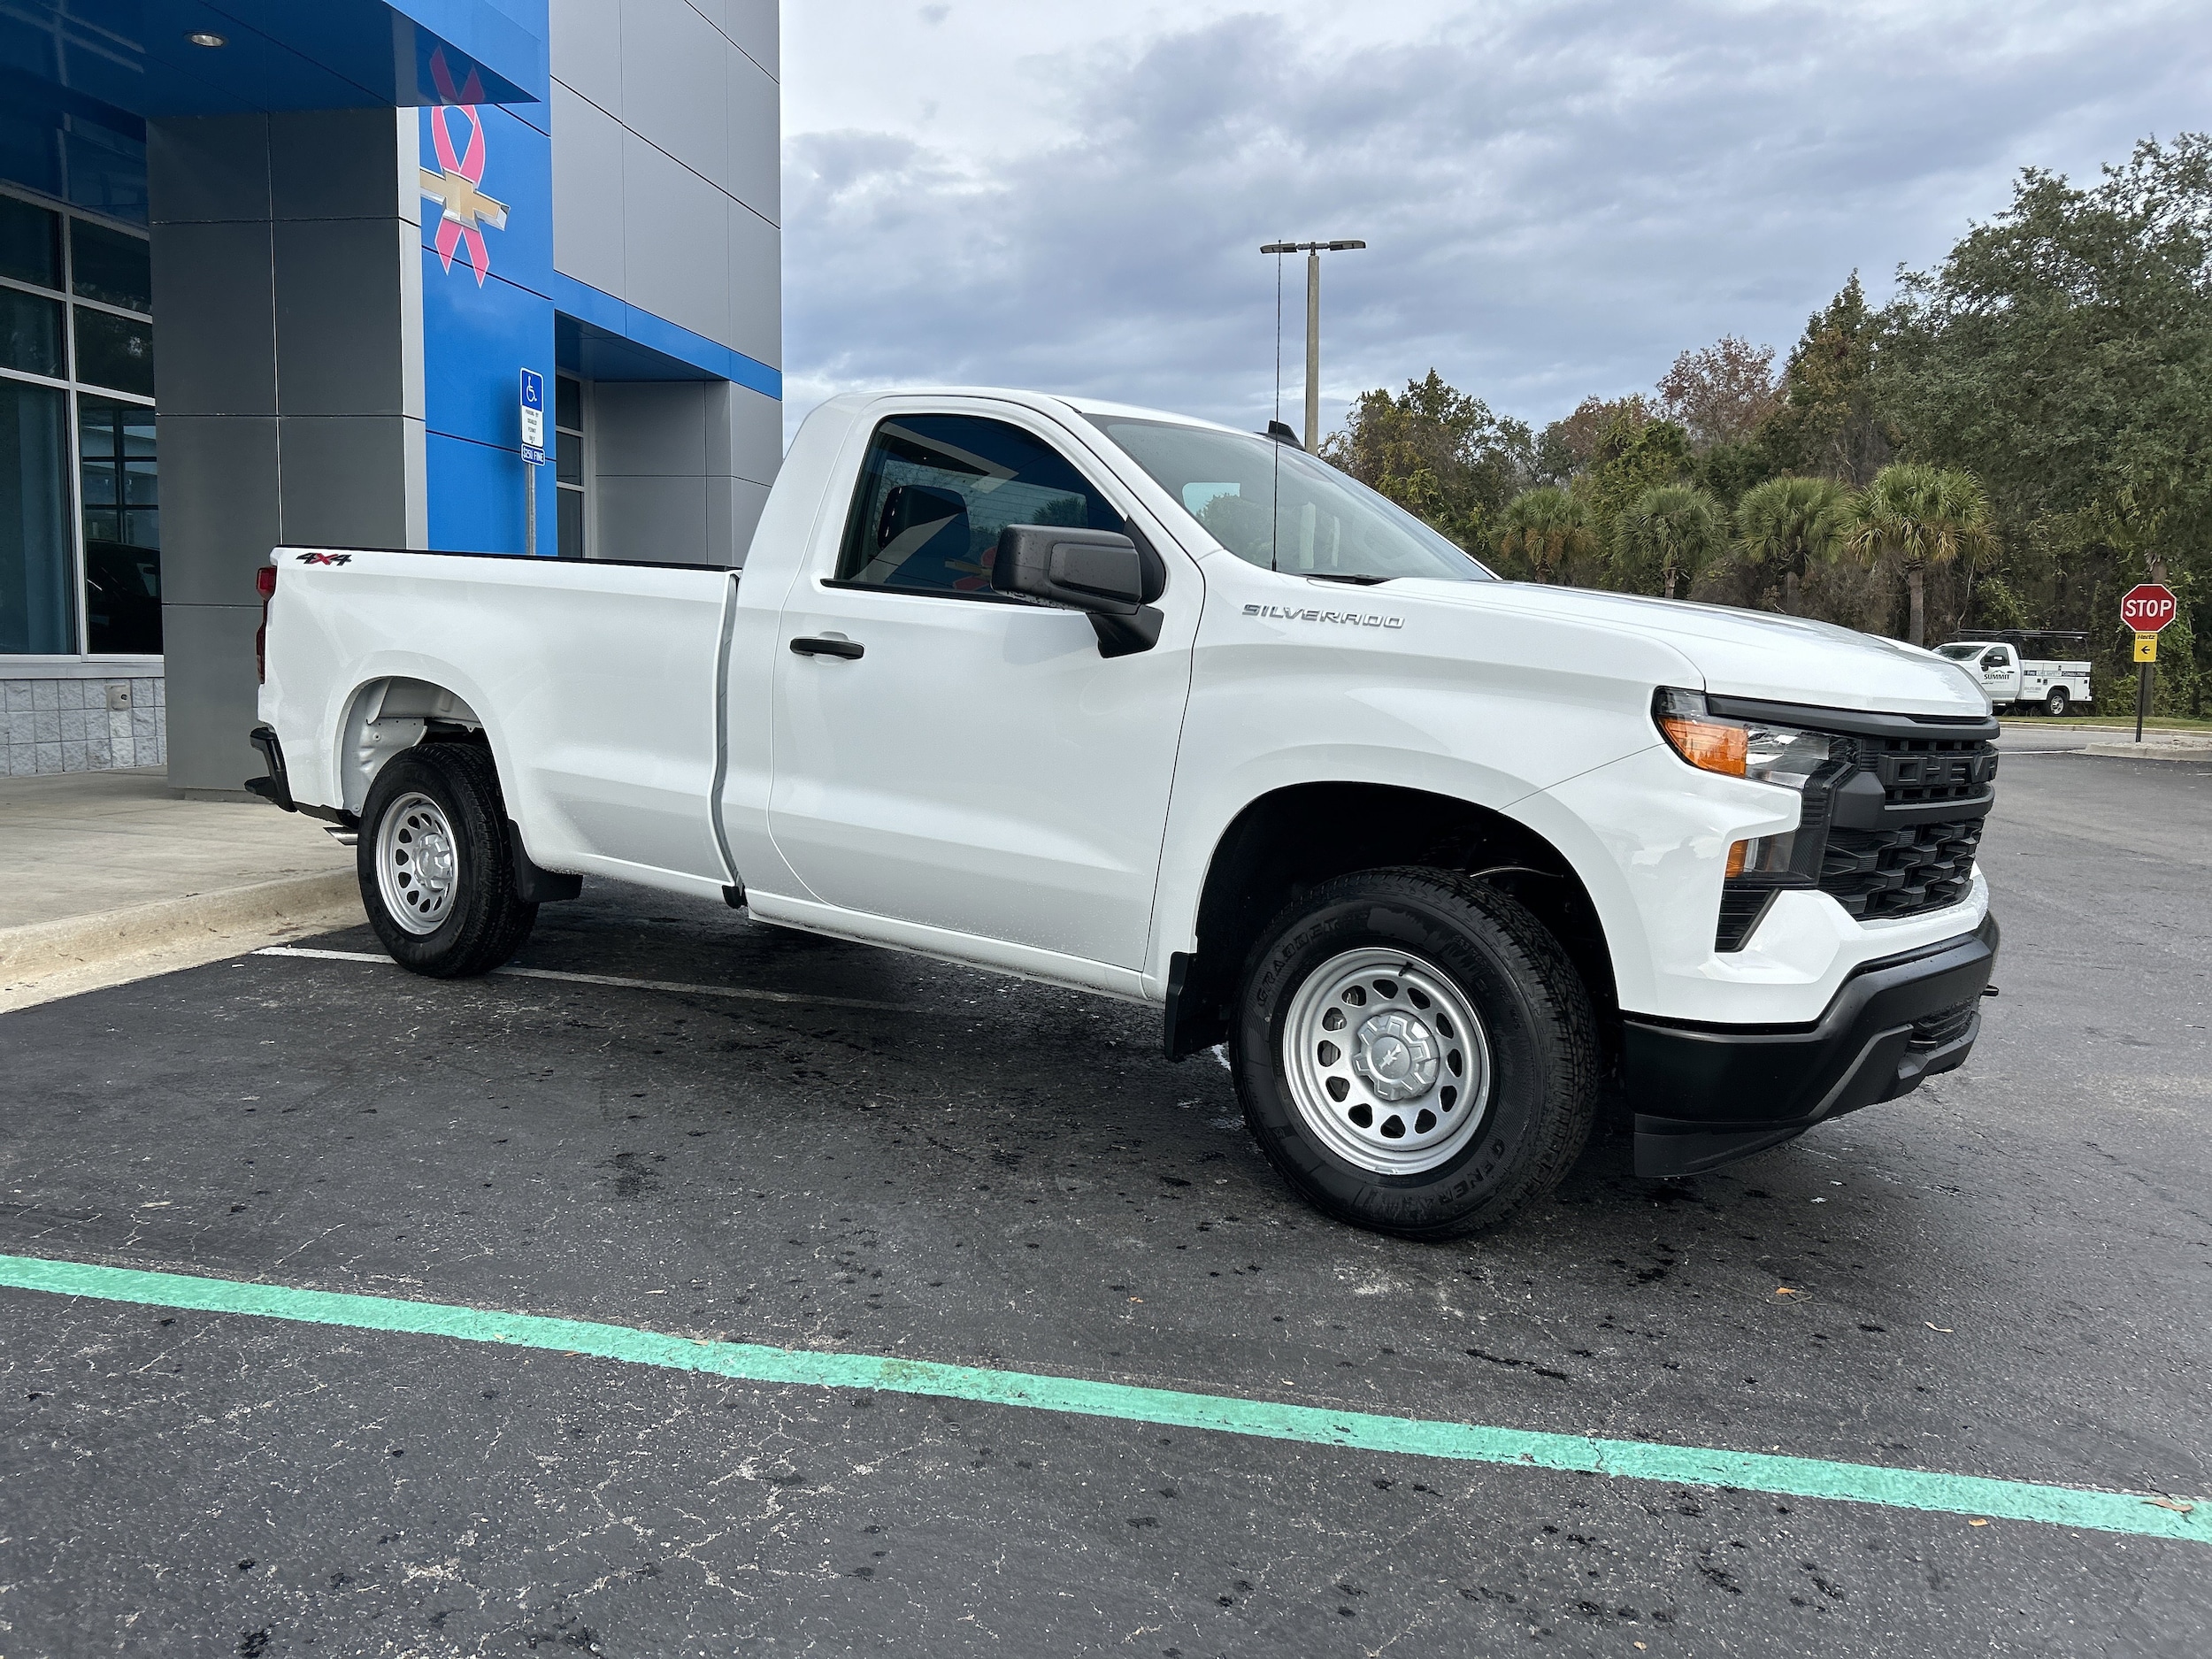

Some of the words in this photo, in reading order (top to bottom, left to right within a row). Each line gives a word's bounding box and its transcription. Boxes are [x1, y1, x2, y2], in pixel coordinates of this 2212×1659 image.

[534, 451, 543, 462] FINE
[1241, 603, 1406, 629] SILVERADO
[2124, 599, 2172, 618] STOP
